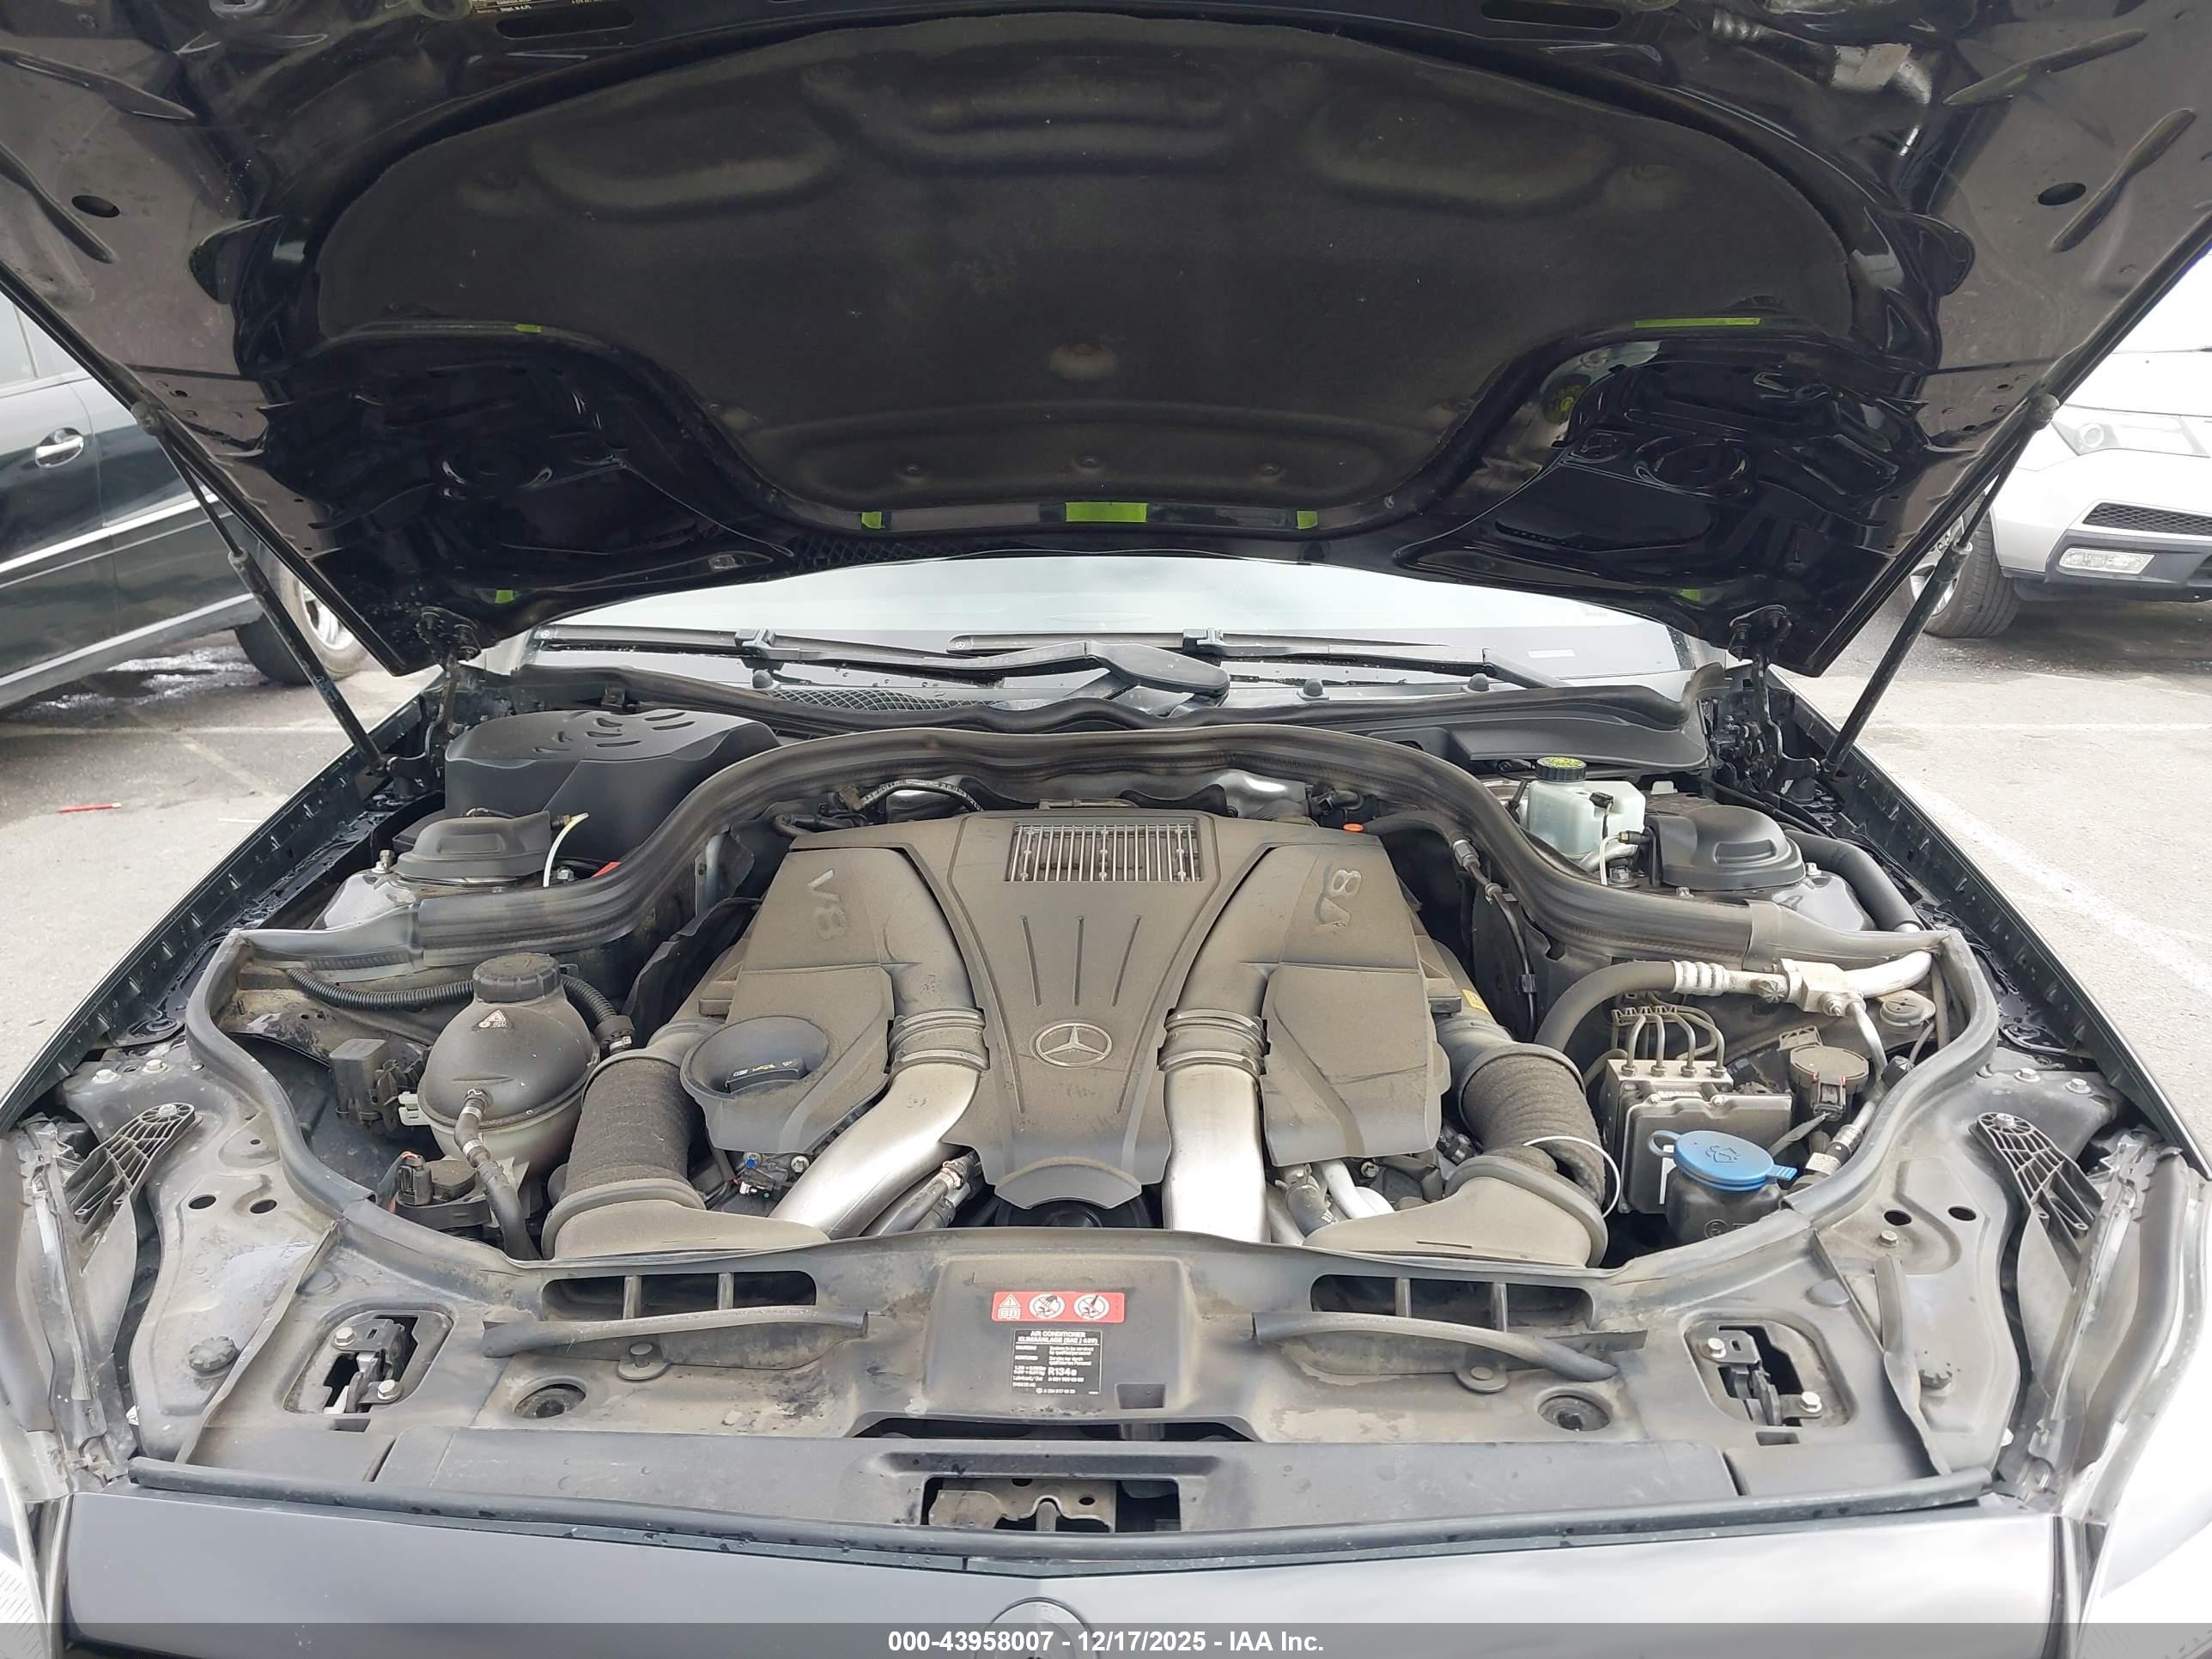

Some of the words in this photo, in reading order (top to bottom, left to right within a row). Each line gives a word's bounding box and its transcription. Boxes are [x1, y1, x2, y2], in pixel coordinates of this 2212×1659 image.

[807, 867, 847, 941] V8
[1316, 866, 1362, 933] V8
[1048, 1366, 1077, 1376] R134a
